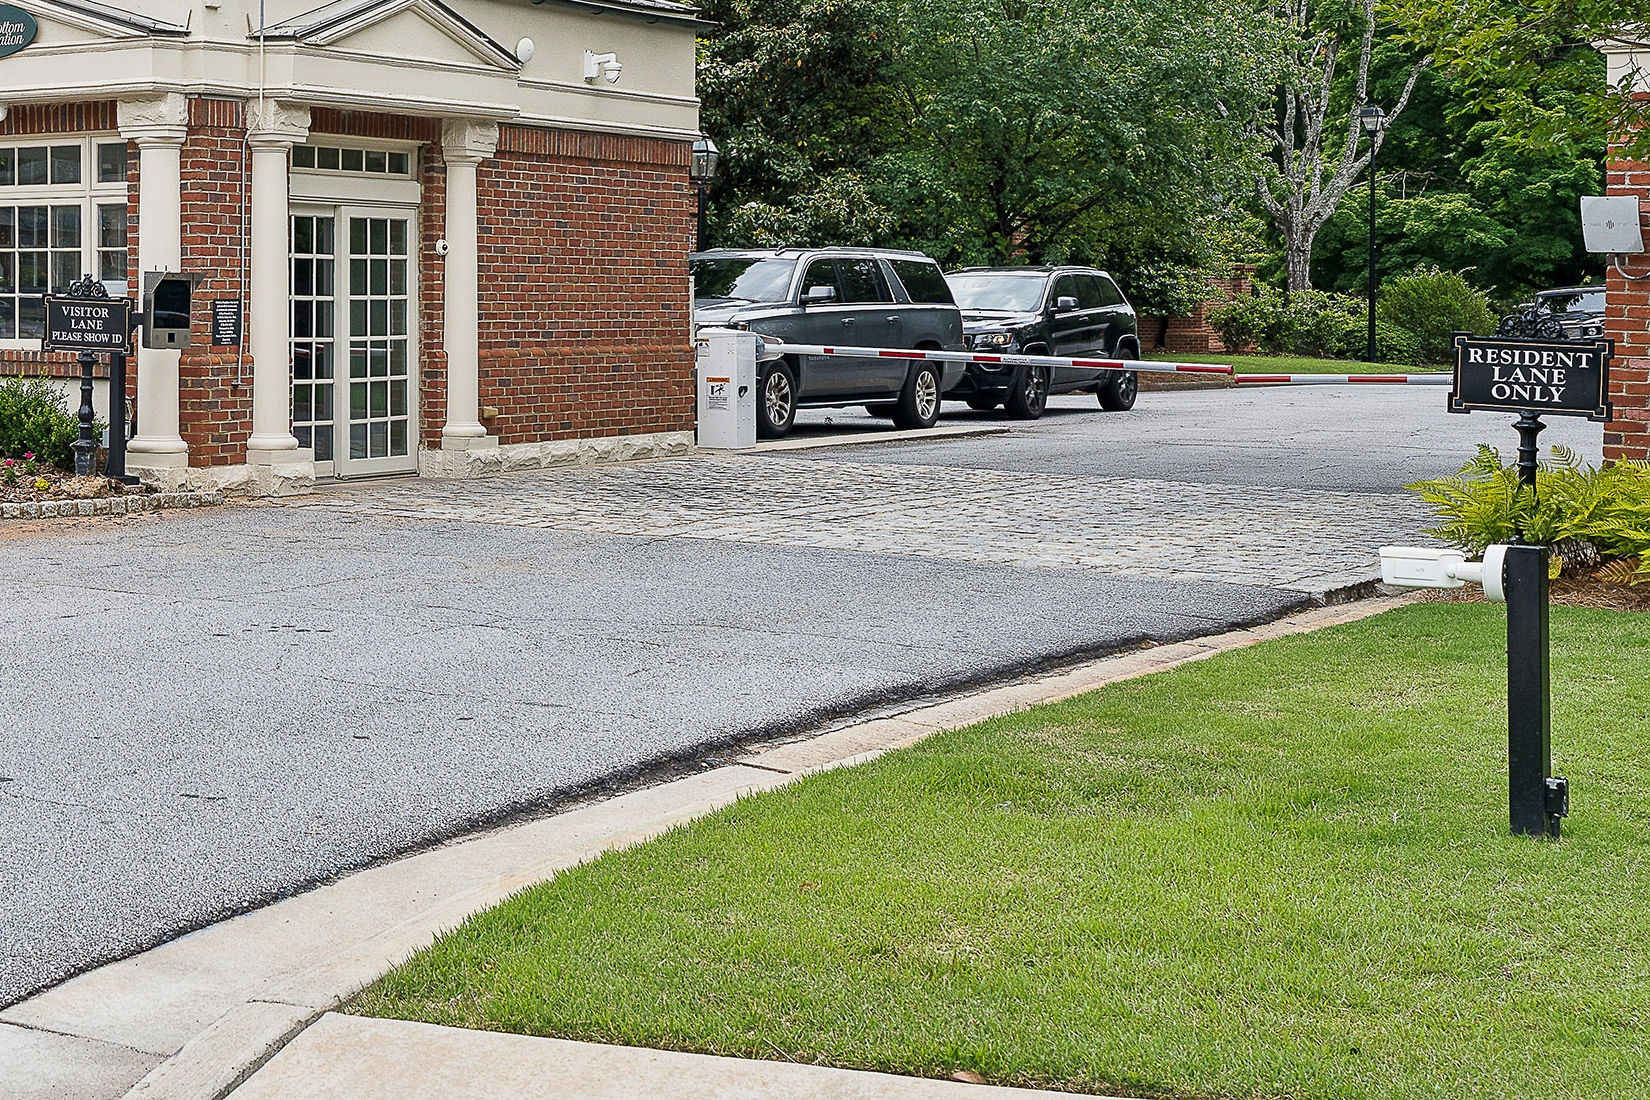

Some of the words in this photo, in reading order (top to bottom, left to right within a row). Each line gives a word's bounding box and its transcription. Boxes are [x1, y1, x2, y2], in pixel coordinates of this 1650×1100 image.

[62, 306, 109, 318] VISITOR
[71, 319, 103, 330] LANE
[52, 331, 82, 341] PLEASE
[84, 333, 110, 342] SHOW
[112, 334, 122, 343] ID
[1468, 347, 1593, 368] RESIDENT
[1492, 365, 1567, 385] LANE
[1491, 383, 1566, 402] ONLY
